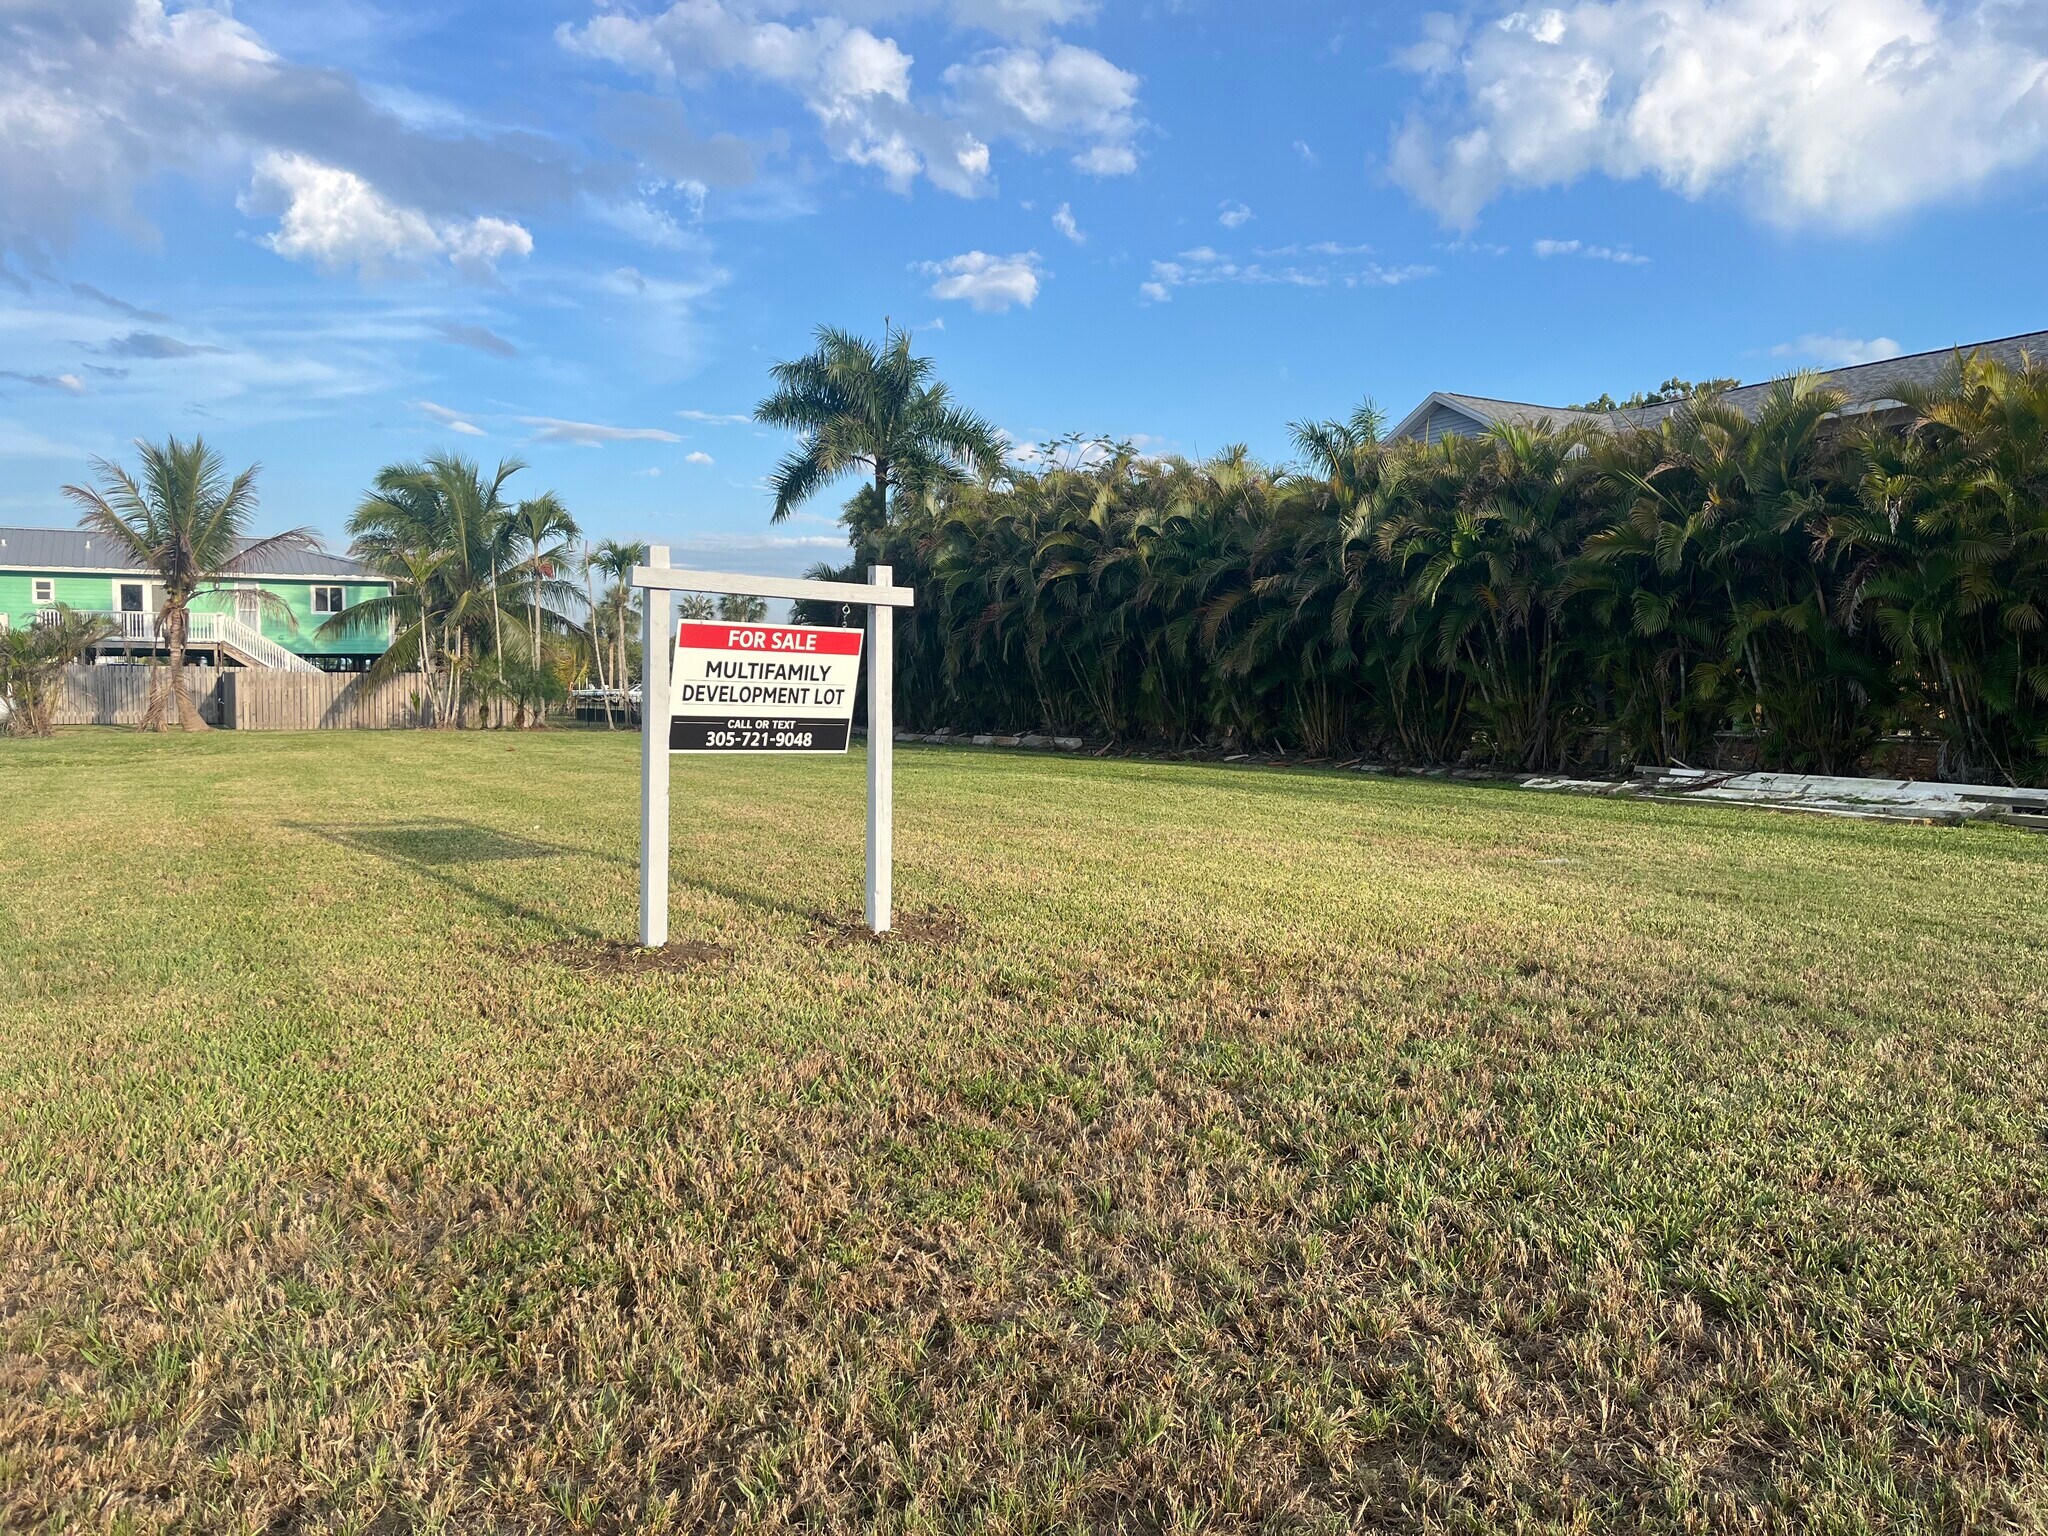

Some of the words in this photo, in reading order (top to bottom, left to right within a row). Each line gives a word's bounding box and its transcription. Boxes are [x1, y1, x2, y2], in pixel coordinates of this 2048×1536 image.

[727, 630, 766, 649] FOR
[771, 631, 818, 651] SALE
[705, 661, 832, 682] MULTIFAMILY
[682, 684, 810, 705] DEVELOPMENT
[814, 688, 845, 705] LOT
[727, 719, 753, 729] CALL
[754, 720, 769, 730] OR
[772, 720, 796, 730] TEXT
[705, 731, 813, 747] 305-721-9048
